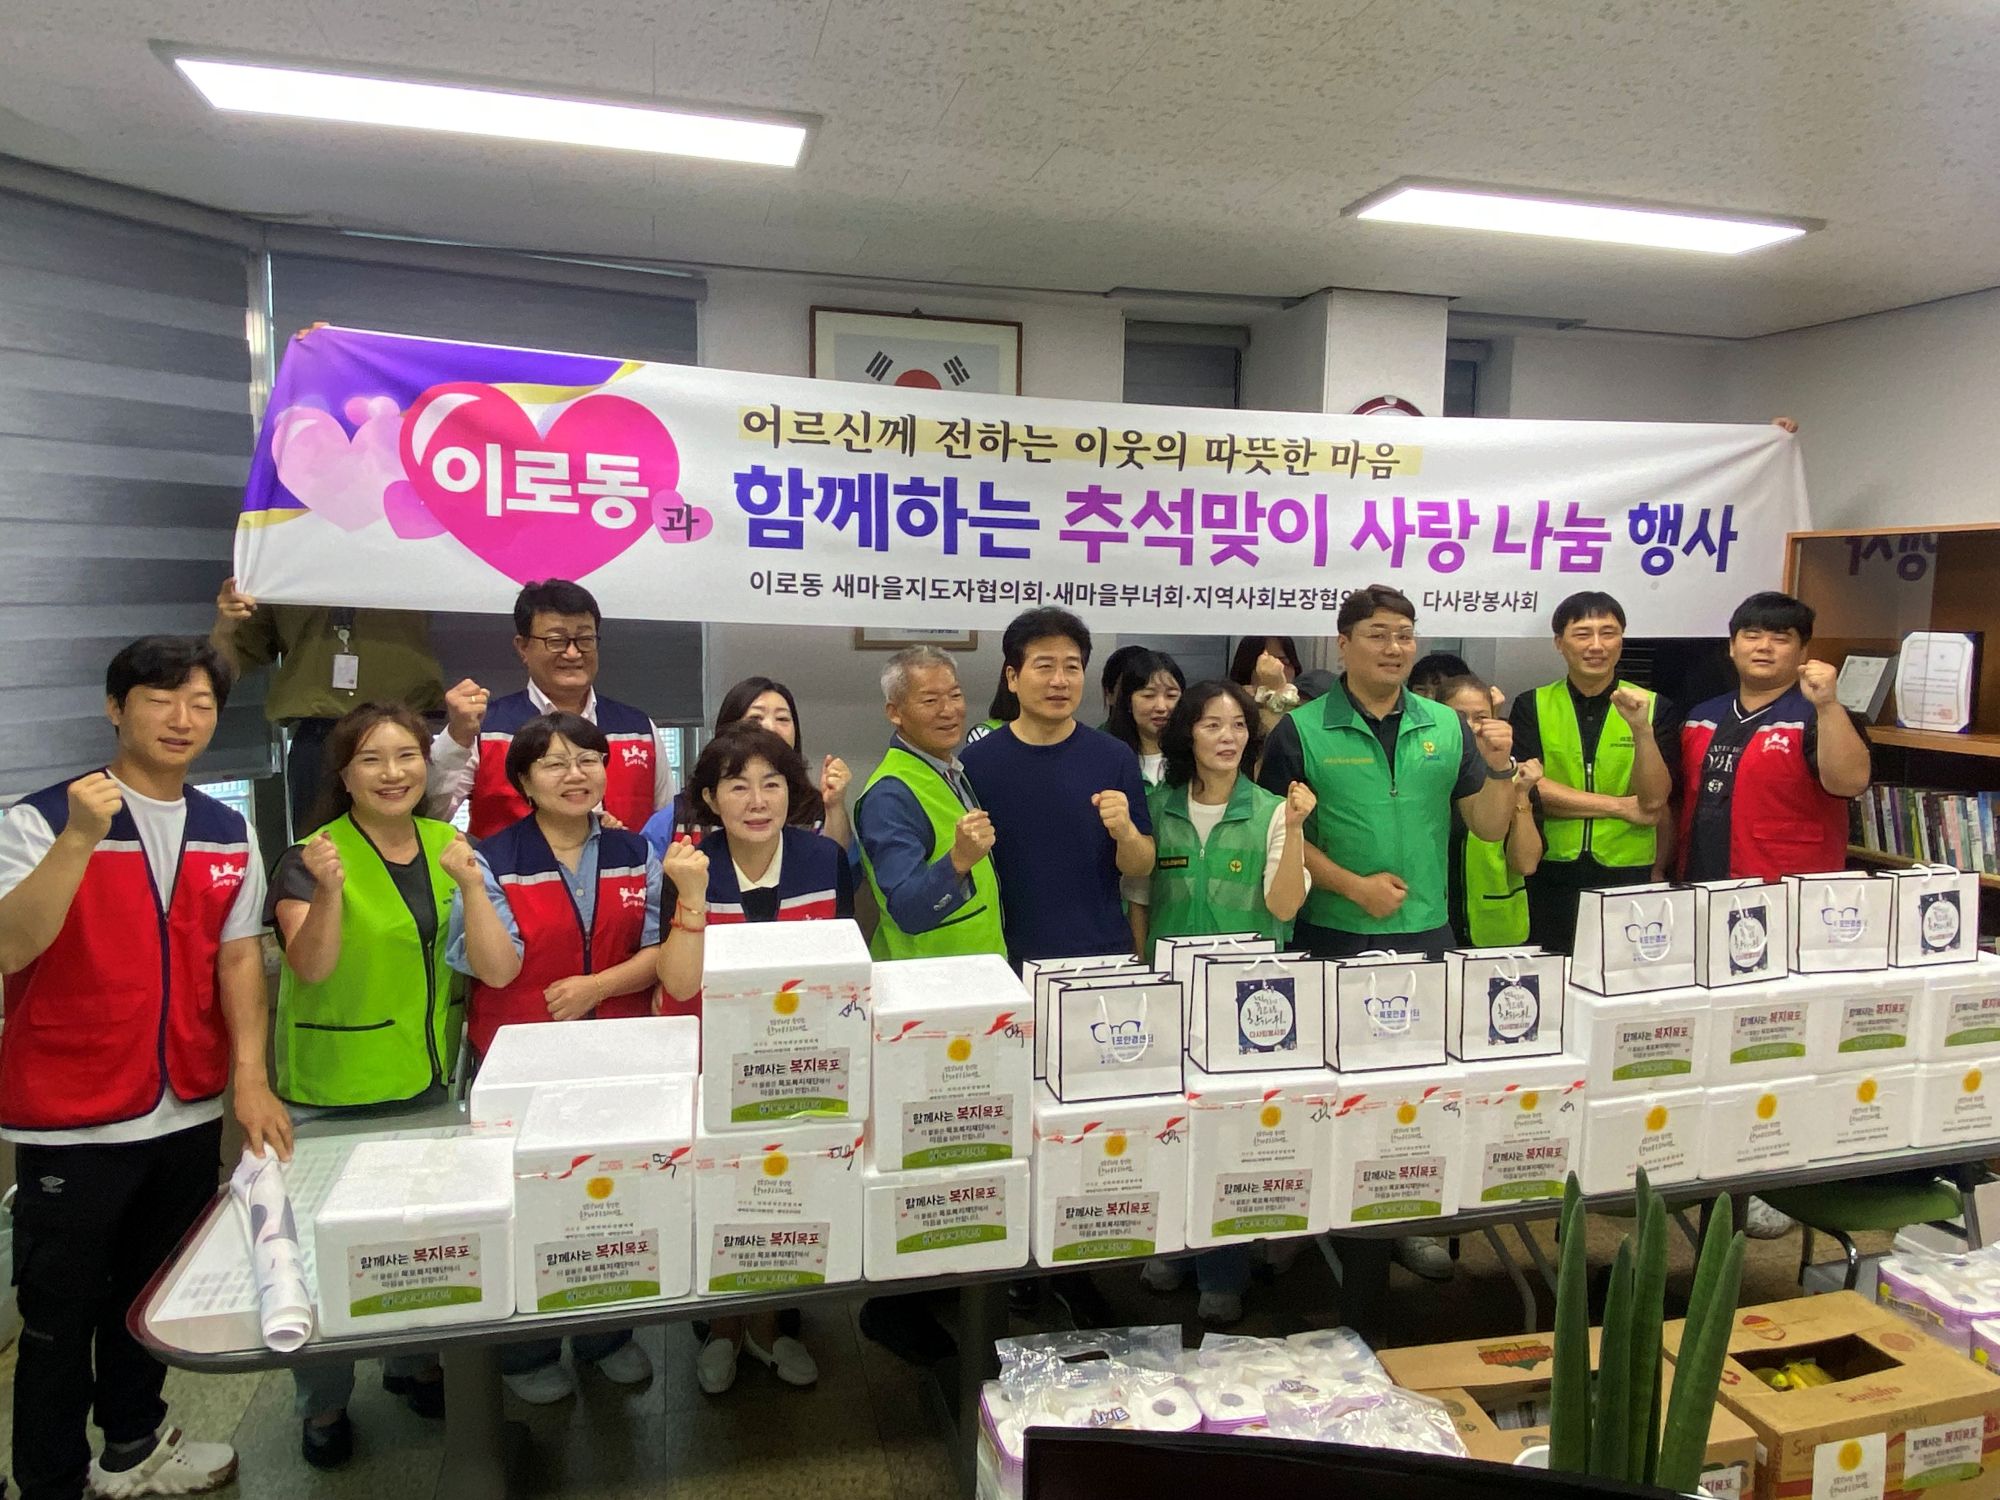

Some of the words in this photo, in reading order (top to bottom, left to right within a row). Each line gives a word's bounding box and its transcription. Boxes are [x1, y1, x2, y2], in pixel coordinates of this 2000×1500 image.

[744, 403, 915, 457] 어르신께
[936, 417, 1058, 463] 전하는
[1075, 427, 1187, 471] 이웃의
[1205, 433, 1317, 476] 따뜻한
[1331, 440, 1400, 480] 마음
[432, 443, 649, 529] 이로동
[661, 503, 700, 541] 과
[734, 465, 1040, 559] 함께하는
[1059, 485, 1328, 567] 추석맞이
[1350, 497, 1480, 573] 사랑
[1492, 500, 1612, 573] 나눔
[1628, 502, 1738, 576] 행사
[750, 570, 823, 597] 이로동
[1423, 590, 1538, 612] 다사랑봉사회
[743, 1063, 786, 1077] 함께사는
[790, 1057, 841, 1073] 복지목포
[913, 1110, 954, 1125] 함께사는
[956, 1105, 1005, 1120] 복지목포
[905, 1193, 945, 1210] 함께사는
[949, 1186, 997, 1202] 복지목포
[1224, 1182, 1260, 1195] 함께사는
[1262, 1177, 1304, 1191] 복지목포
[1065, 1206, 1103, 1219] 함께사는
[1106, 1201, 1150, 1216] 복지목포
[723, 1235, 766, 1248] 함께사는
[769, 1230, 820, 1246] 복지목포
[360, 1253, 409, 1270] 함께사는
[412, 1244, 470, 1263] 복지목포
[546, 1249, 592, 1267] 함께사는
[595, 1240, 649, 1259] 복지목포
